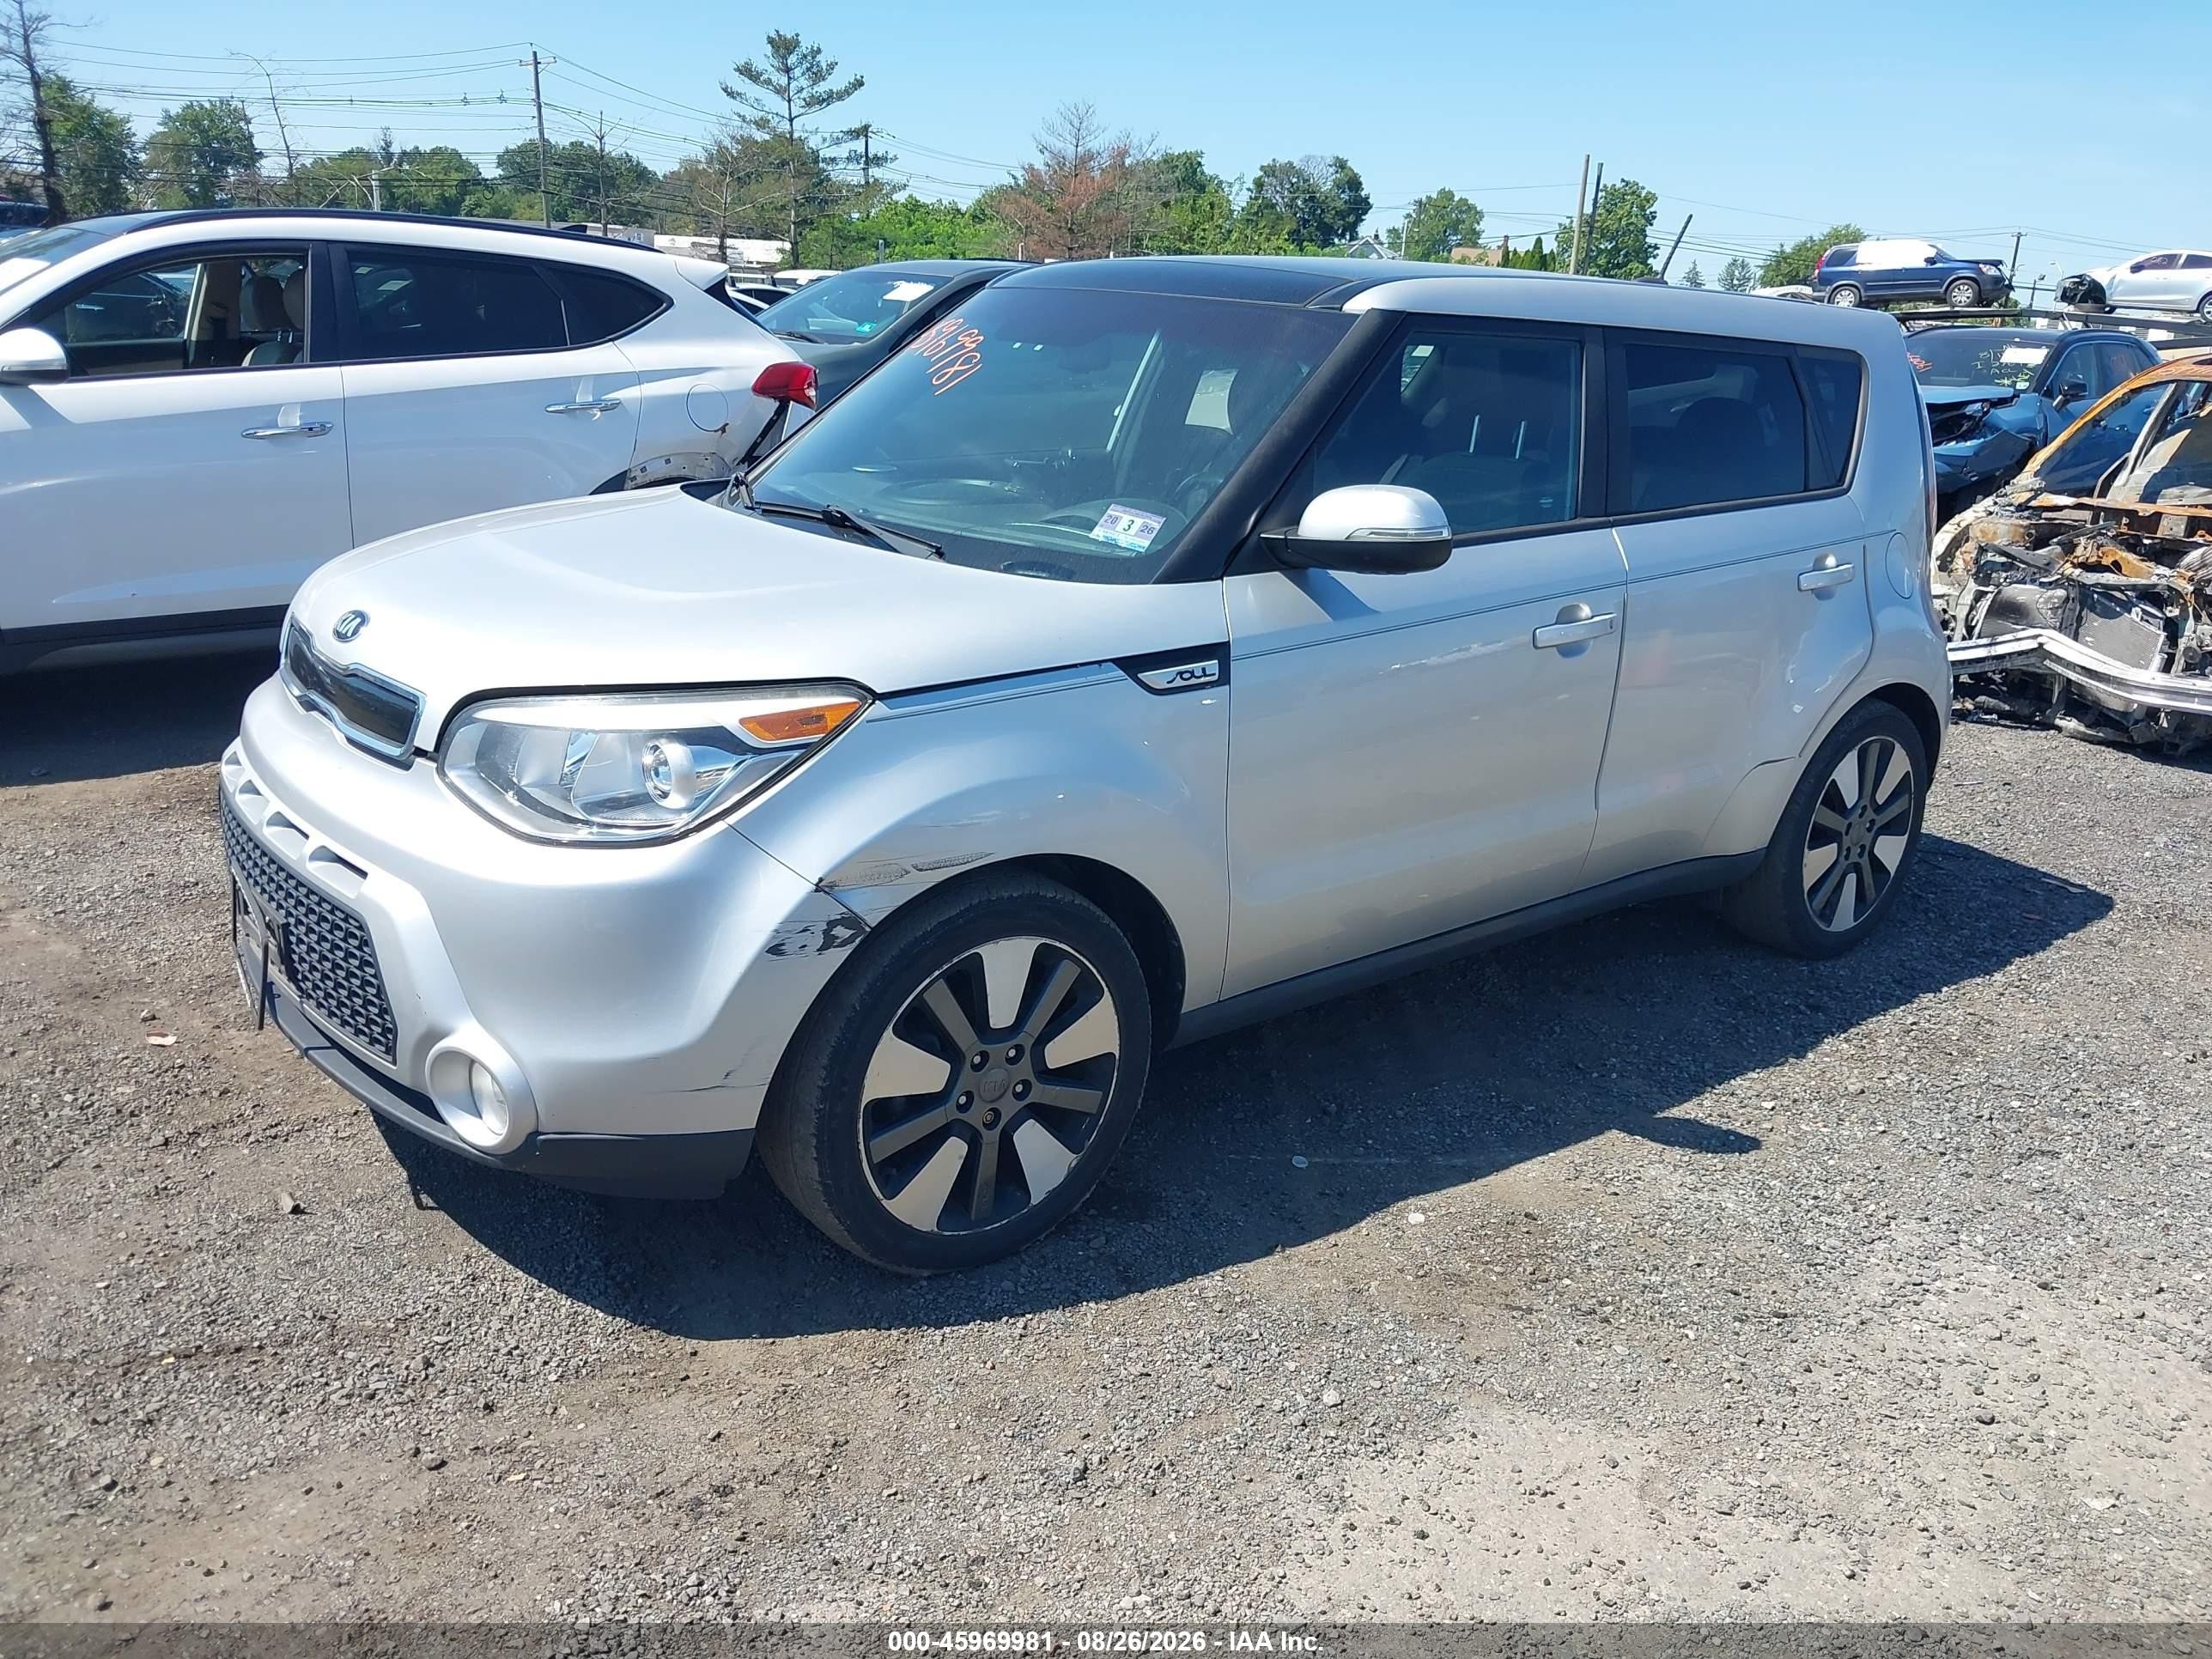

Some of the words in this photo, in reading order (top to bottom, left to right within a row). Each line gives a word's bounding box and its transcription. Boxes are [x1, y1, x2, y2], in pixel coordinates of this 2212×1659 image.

[1103, 514, 1120, 526] 20
[1122, 519, 1135, 532] 3
[1139, 524, 1155, 535] 26
[336, 611, 364, 639] KIA
